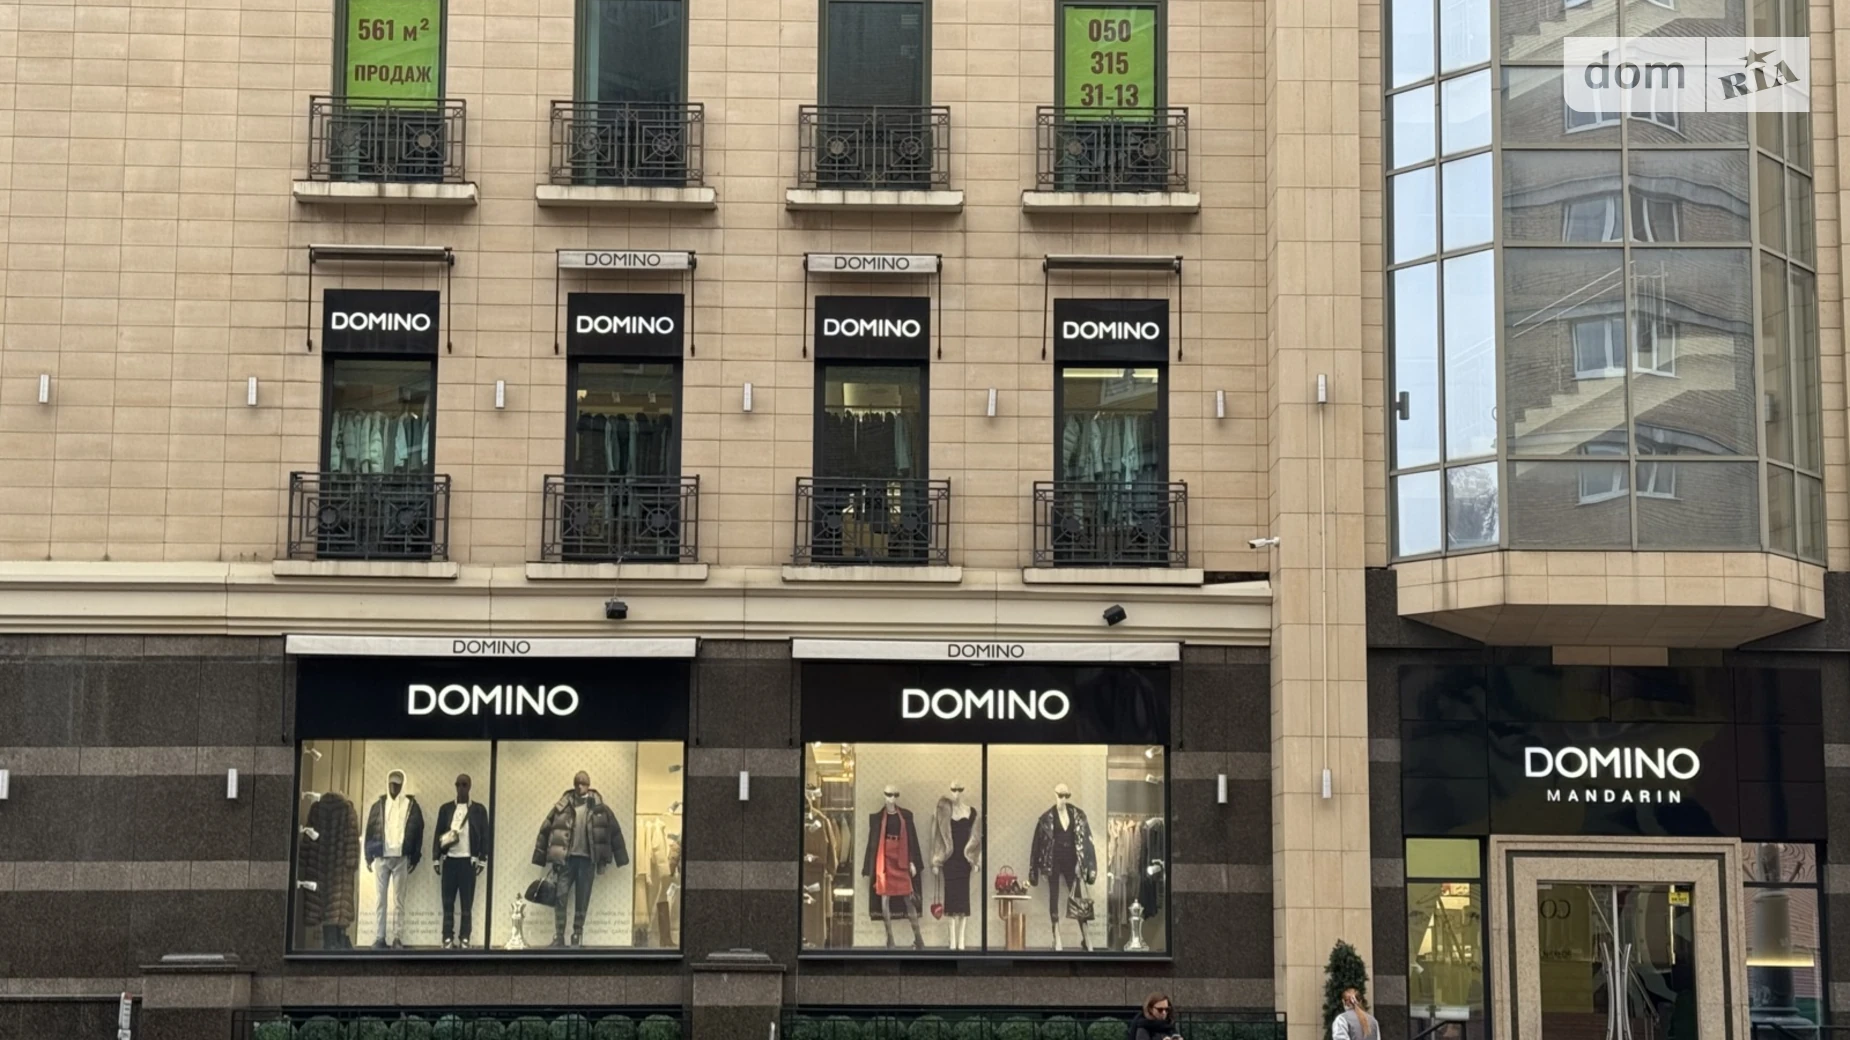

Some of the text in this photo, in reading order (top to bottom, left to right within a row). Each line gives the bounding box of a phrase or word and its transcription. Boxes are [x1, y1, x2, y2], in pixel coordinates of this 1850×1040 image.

[357, 18, 395, 42] 561
[1088, 18, 1132, 43] 050
[1090, 50, 1130, 75] 315
[354, 63, 433, 86] ПРОДАЖ
[1080, 83, 1140, 107] 31-13
[584, 252, 661, 267] DOMINO
[834, 255, 910, 271] DOMINO
[331, 311, 431, 332] DOMINO
[576, 315, 675, 335] DOMINO
[823, 318, 921, 338] DOMINO
[1062, 321, 1160, 340] DOMINO
[452, 639, 531, 655] DOMINO
[947, 643, 1025, 659] DOMINO
[407, 684, 579, 716] DOMINO
[902, 688, 1070, 721] DOMINO
[1524, 746, 1701, 780] DOMINO
[1547, 789, 1681, 804] MANDARIN
